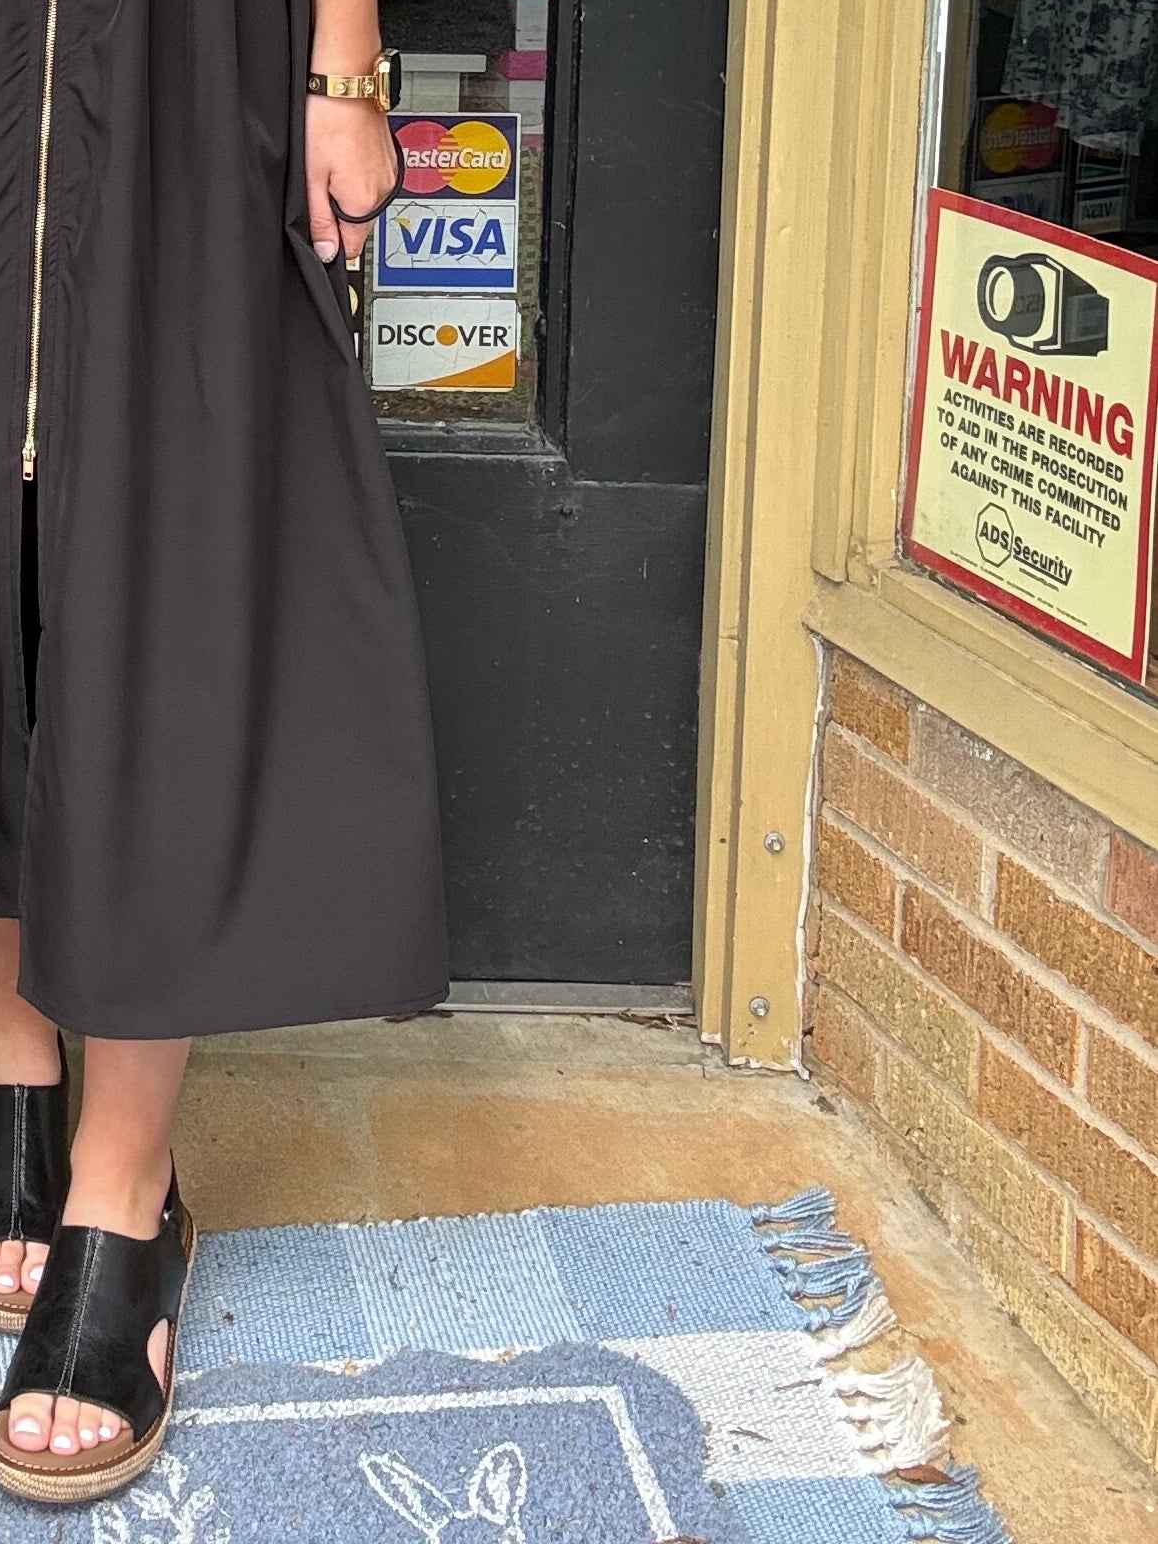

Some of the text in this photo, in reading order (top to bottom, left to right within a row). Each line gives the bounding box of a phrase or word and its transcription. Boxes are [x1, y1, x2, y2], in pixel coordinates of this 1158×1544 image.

[395, 217, 507, 256] VISA
[377, 324, 509, 347] DISCOVER
[941, 328, 1134, 460] WARNING
[943, 388, 1124, 483] ACTIVITIES ARE RECORDED
[937, 406, 1128, 512] TO AID IN THE PROSECUTION
[940, 432, 1121, 532] OF ANY CRIME COMMITTED
[950, 460, 1106, 549] AGAINST THIS FACILITY
[978, 520, 1010, 551] ADS
[1012, 535, 1073, 582] Security
